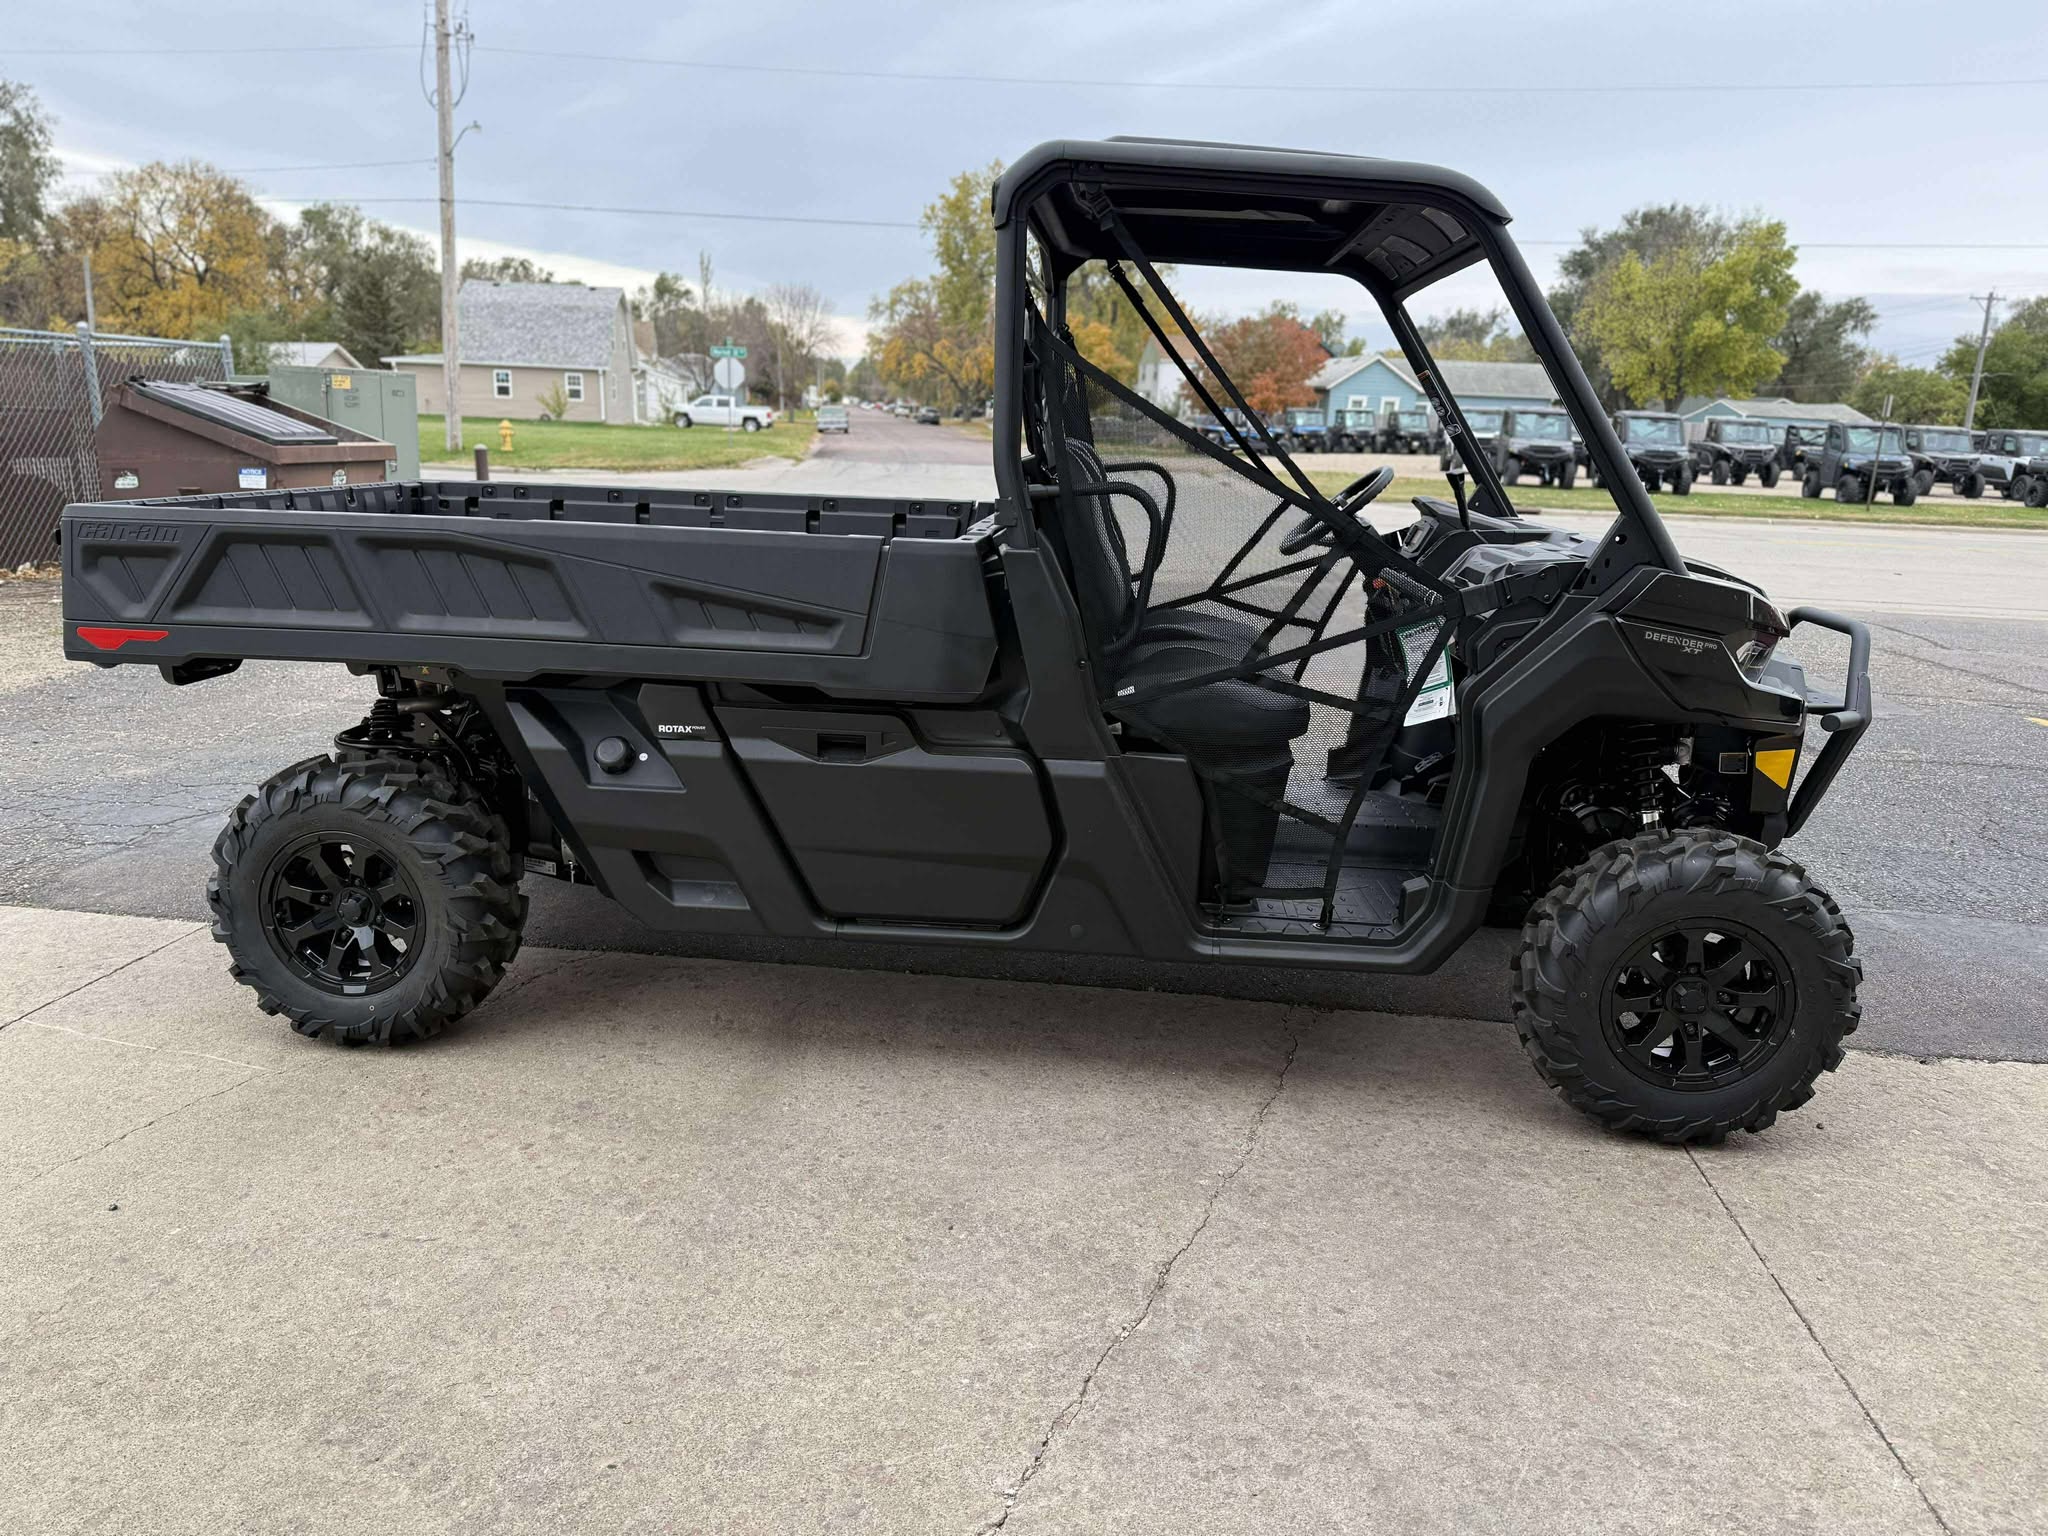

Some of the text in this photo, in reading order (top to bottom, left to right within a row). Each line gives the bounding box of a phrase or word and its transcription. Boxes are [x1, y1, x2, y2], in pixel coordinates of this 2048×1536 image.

[1645, 631, 1718, 650] DEFENDER PRO
[658, 724, 692, 733] ROTAX
